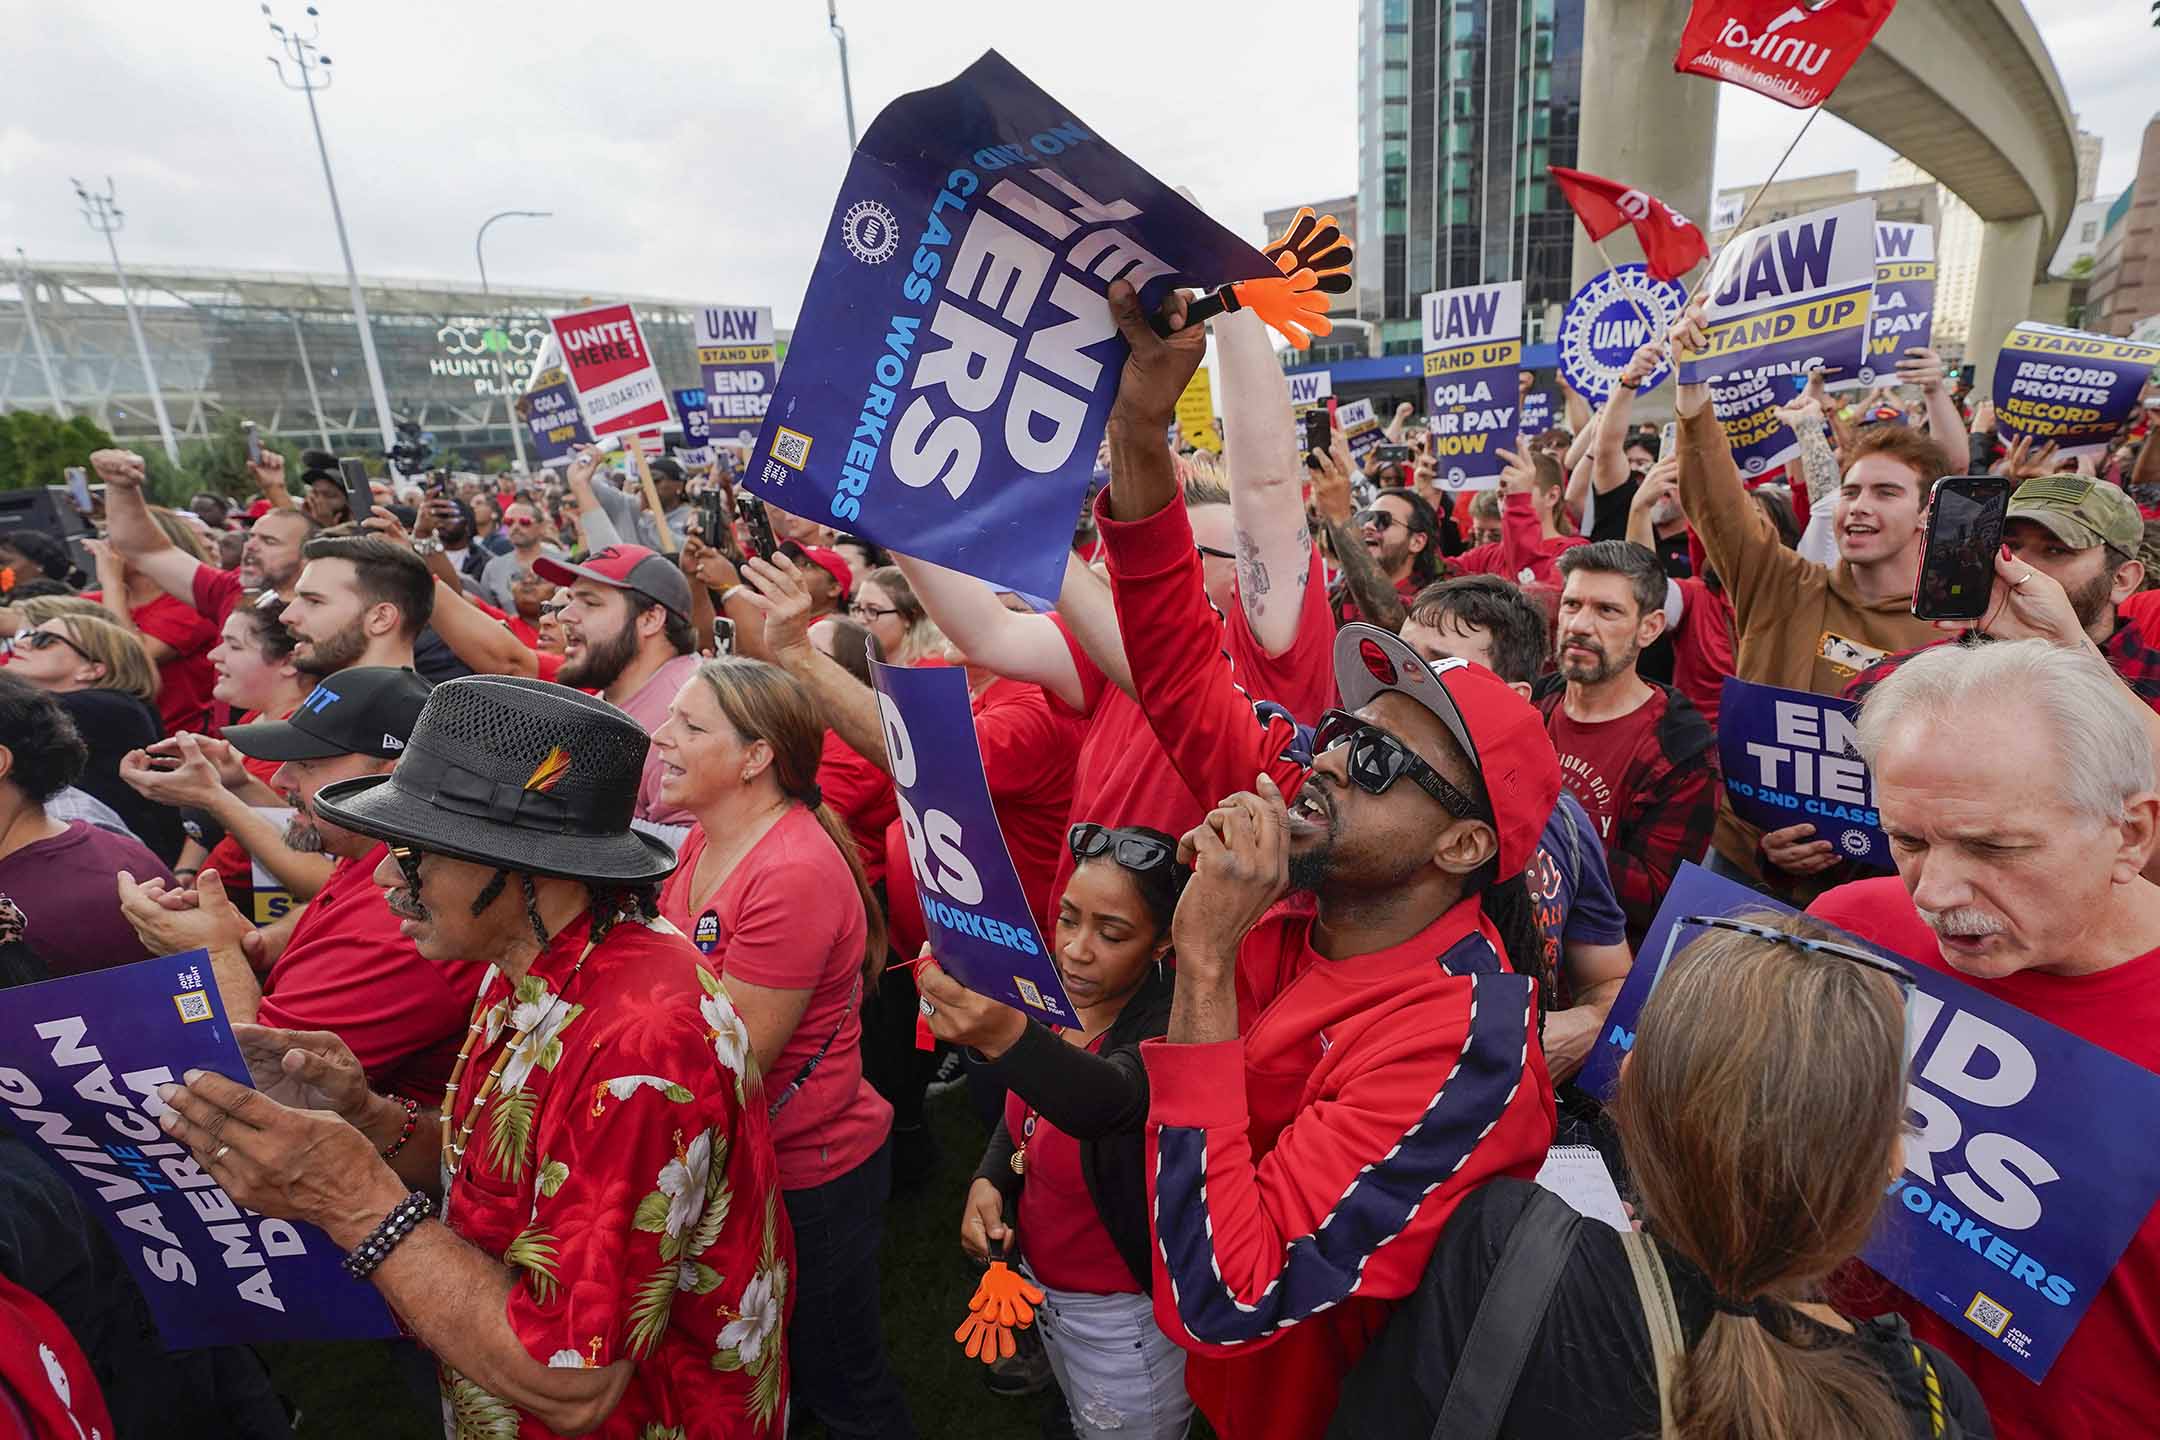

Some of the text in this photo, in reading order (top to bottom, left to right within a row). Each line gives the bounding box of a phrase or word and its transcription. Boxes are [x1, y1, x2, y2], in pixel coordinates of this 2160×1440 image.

[1031, 120, 1089, 155] NO
[863, 219, 881, 247] UAW
[903, 168, 979, 305] CLASS
[1900, 265, 1927, 277] UP
[705, 310, 757, 340] UAW
[1433, 291, 1500, 341] UAW
[1693, 300, 1855, 356] STAND UP
[1875, 312, 1928, 336] PAY
[563, 320, 632, 351] UNITE
[889, 167, 1144, 501] TIERS
[1593, 320, 1646, 349] UAW
[2014, 334, 2105, 354] STAND
[2113, 346, 2153, 360] UP
[703, 350, 769, 361] STAND UP
[1427, 346, 1512, 373] STAND UP
[713, 371, 765, 393] END
[2017, 362, 2117, 388] RECORD
[587, 379, 657, 415] SOLIDARITY!
[1289, 377, 1318, 404] AW
[1434, 381, 1492, 407] COLA
[2011, 379, 2110, 405] PROFITS
[830, 314, 921, 524] WORKERS
[1430, 413, 1459, 434] AIR
[1463, 407, 1514, 432] PAY
[2007, 398, 2100, 422] RECORD
[1437, 433, 1488, 456] NOW
[761, 459, 774, 484] FIGHT
[770, 464, 781, 480] THE
[776, 467, 788, 486] JOIN
[1775, 700, 1858, 754] EN
[1758, 788, 1799, 809] 2ND
[1804, 800, 1879, 827] CLASS
[921, 894, 1040, 957] WORKERS
[177, 972, 189, 990] JOIN
[186, 973, 195, 989] THE
[190, 965, 203, 988] FIGHT
[34, 1015, 286, 1312] AMERICAN
[103, 1145, 173, 1194] THE
[2002, 1336, 2031, 1359] FIGHT
[2007, 1331, 2026, 1348] THE
[2009, 1327, 2032, 1345] JOIN
